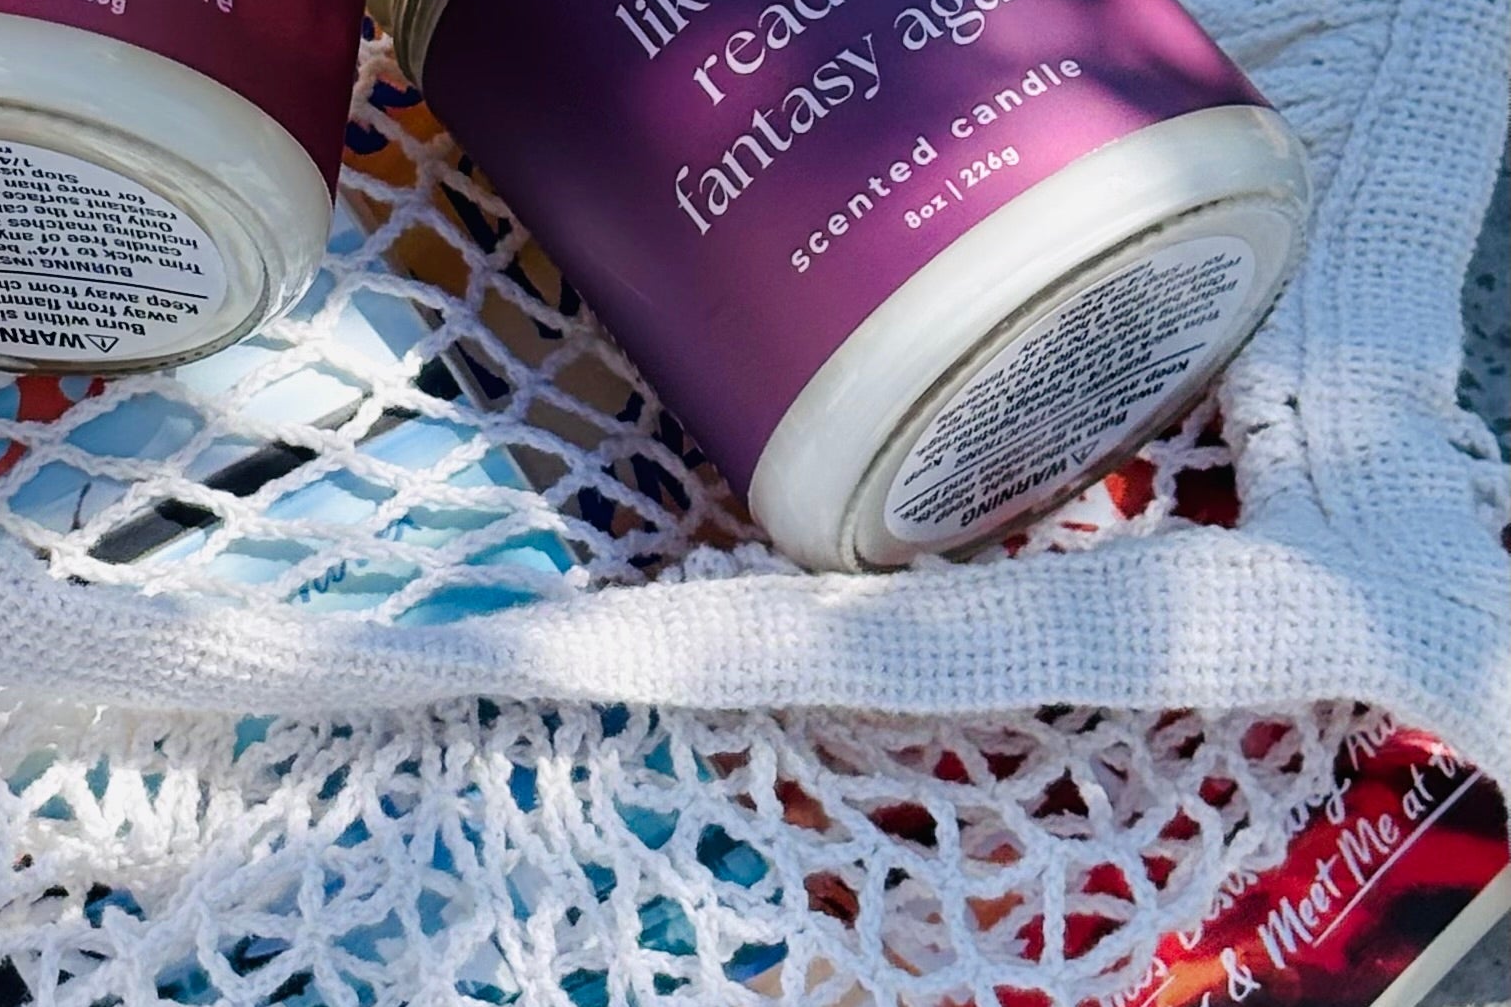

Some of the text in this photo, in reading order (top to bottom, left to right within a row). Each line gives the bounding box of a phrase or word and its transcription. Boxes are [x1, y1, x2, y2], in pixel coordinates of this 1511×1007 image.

[674, 33, 882, 236] fantasy
[790, 55, 1083, 273] scented candle
[32, 169, 78, 183] Stop
[4, 180, 50, 192] than
[58, 185, 110, 196] more
[904, 193, 948, 230] 8oz
[959, 145, 1021, 190] 226g
[118, 193, 145, 205] for
[34, 206, 67, 218] the
[74, 210, 121, 224] burn
[86, 199, 176, 220] resistant
[8, 219, 97, 231] matches
[128, 216, 172, 232] Only
[42, 234, 60, 243] of
[68, 235, 107, 246] free
[103, 224, 197, 249] including
[28, 246, 69, 256] 1/4"
[78, 248, 96, 258] to
[114, 239, 182, 256] candle
[103, 249, 152, 264] wick
[40, 259, 132, 277] BURNING
[159, 258, 202, 274] Trim
[28, 282, 76, 298] from
[85, 287, 138, 303] away
[67, 300, 116, 317] from
[147, 295, 198, 314] Keep
[24, 311, 88, 326] within
[123, 306, 177, 323] away
[96, 318, 145, 335] Burn
[961, 459, 1066, 526] WARNING
[1258, 852, 1342, 970] Meet
[1337, 817, 1400, 887] Me
[1403, 769, 1437, 821] at
